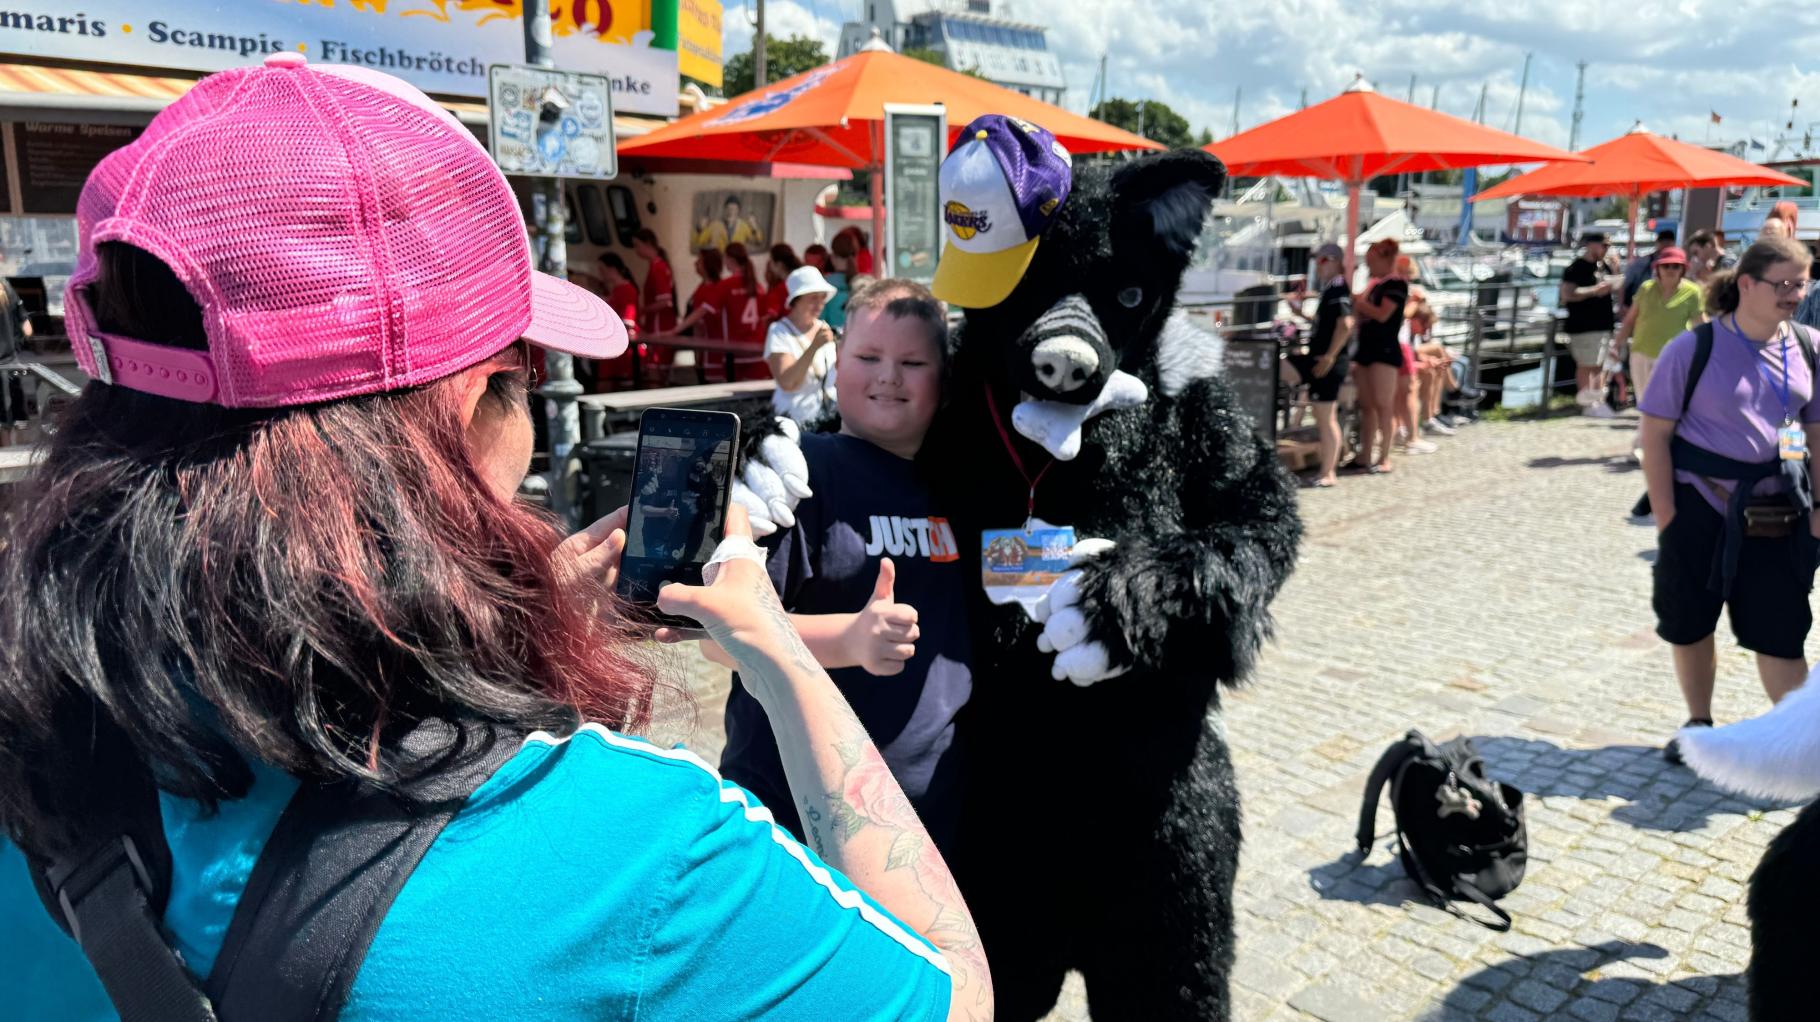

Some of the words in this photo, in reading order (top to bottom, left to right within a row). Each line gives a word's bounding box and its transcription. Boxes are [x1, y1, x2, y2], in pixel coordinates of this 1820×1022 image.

[0, 10, 106, 37] maris
[149, 21, 284, 57] Scampis
[320, 40, 486, 77] Fischbrötch
[611, 75, 651, 95] nke
[741, 297, 760, 331] 4
[865, 515, 930, 558] JUST
